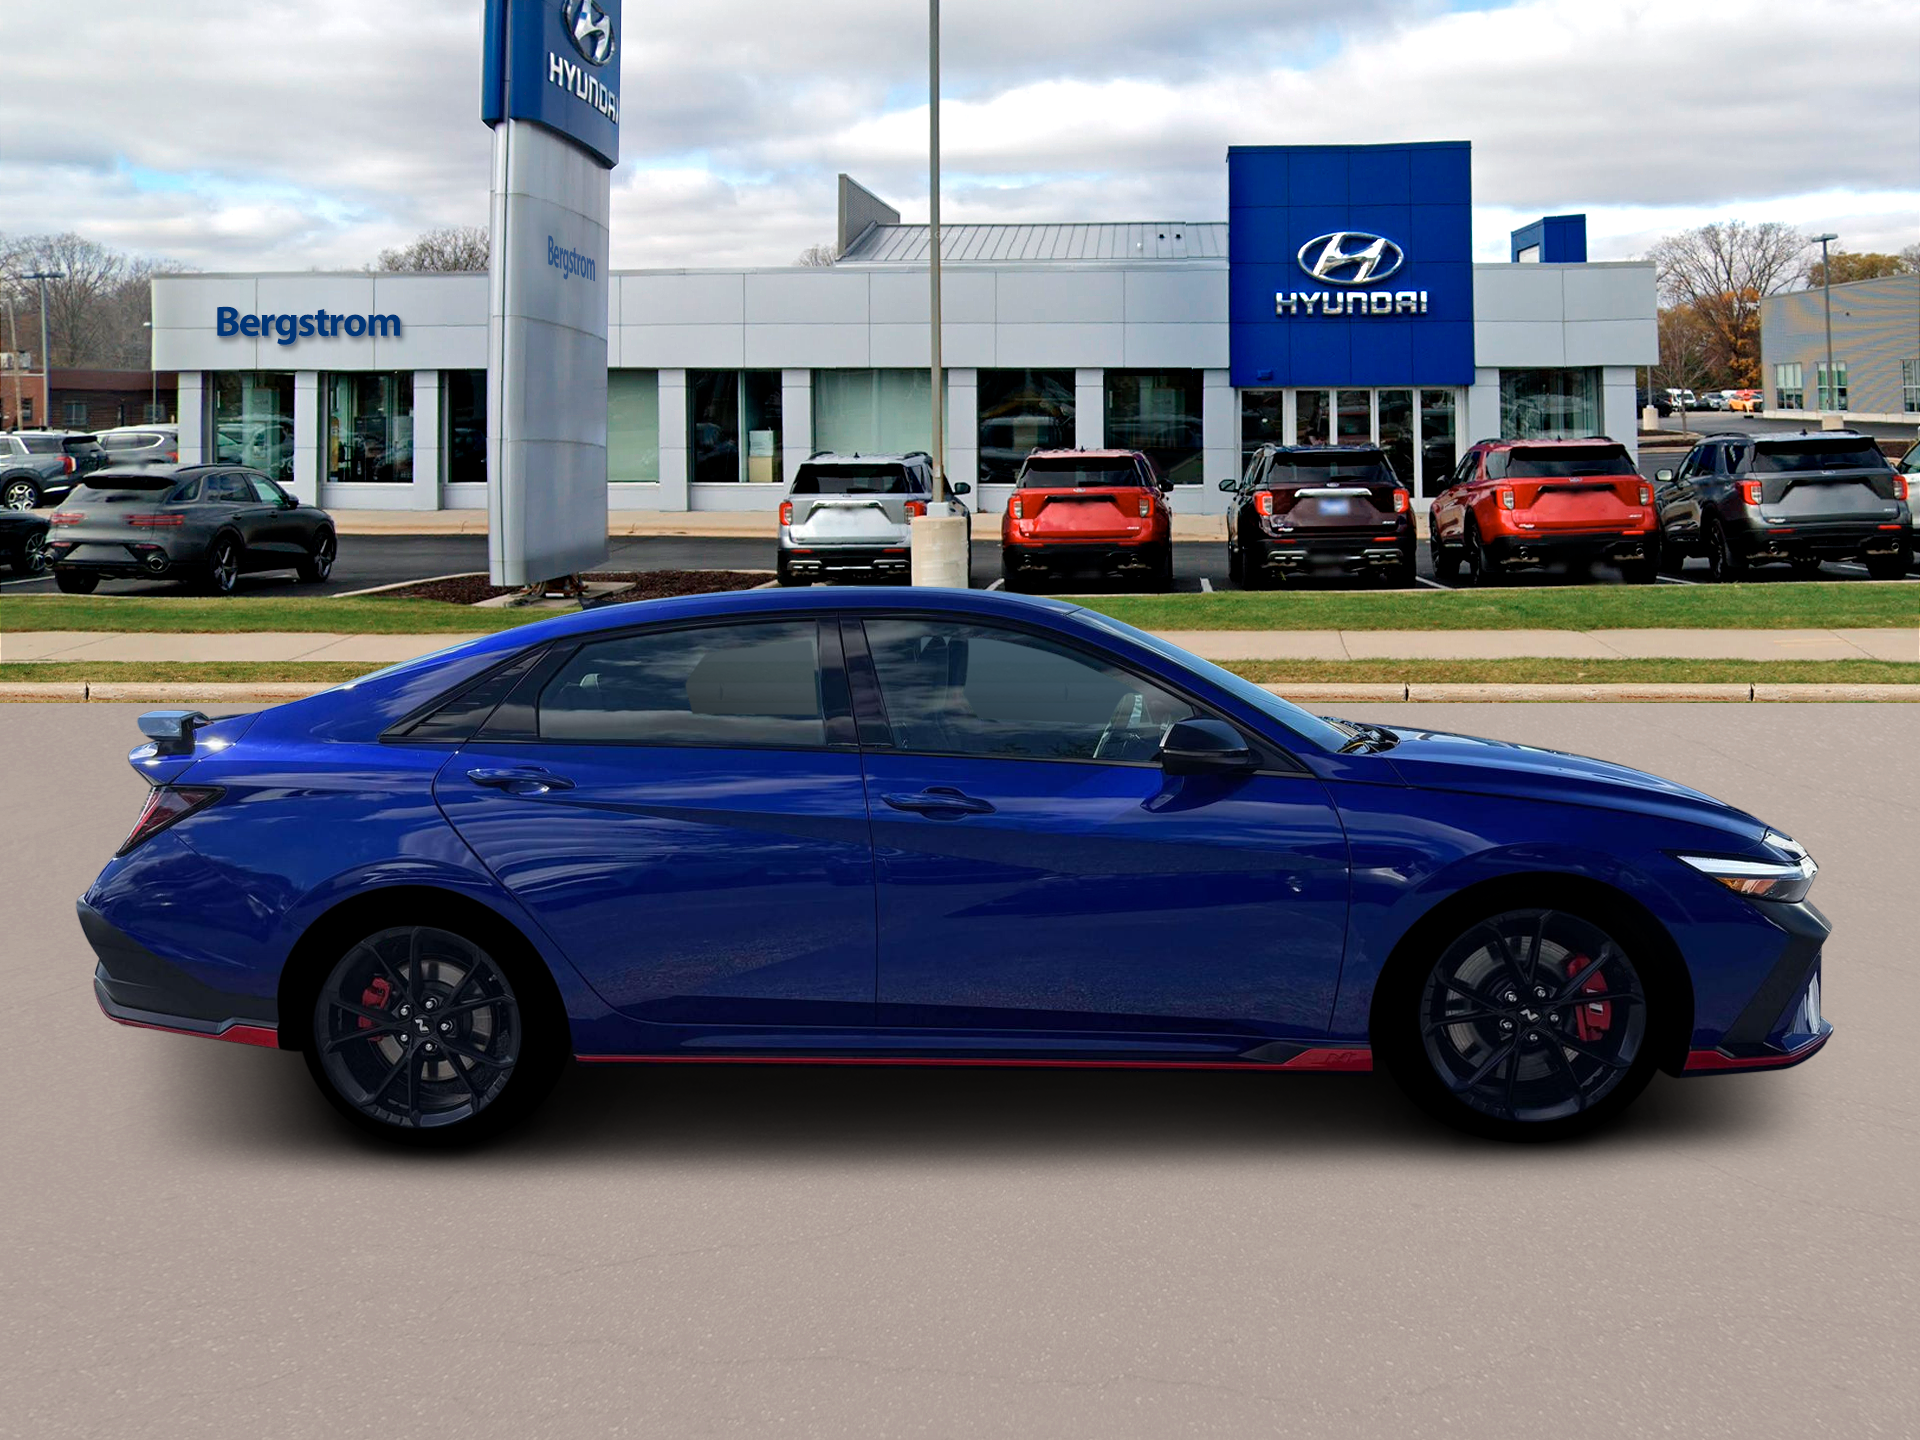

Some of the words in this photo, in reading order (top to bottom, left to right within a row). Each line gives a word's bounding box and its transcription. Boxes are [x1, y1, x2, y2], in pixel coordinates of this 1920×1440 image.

[549, 51, 619, 124] HYUNDAI
[547, 235, 596, 282] Bergstrom
[1275, 291, 1428, 315] HYUNDAI
[216, 306, 401, 346] Bergstrom
